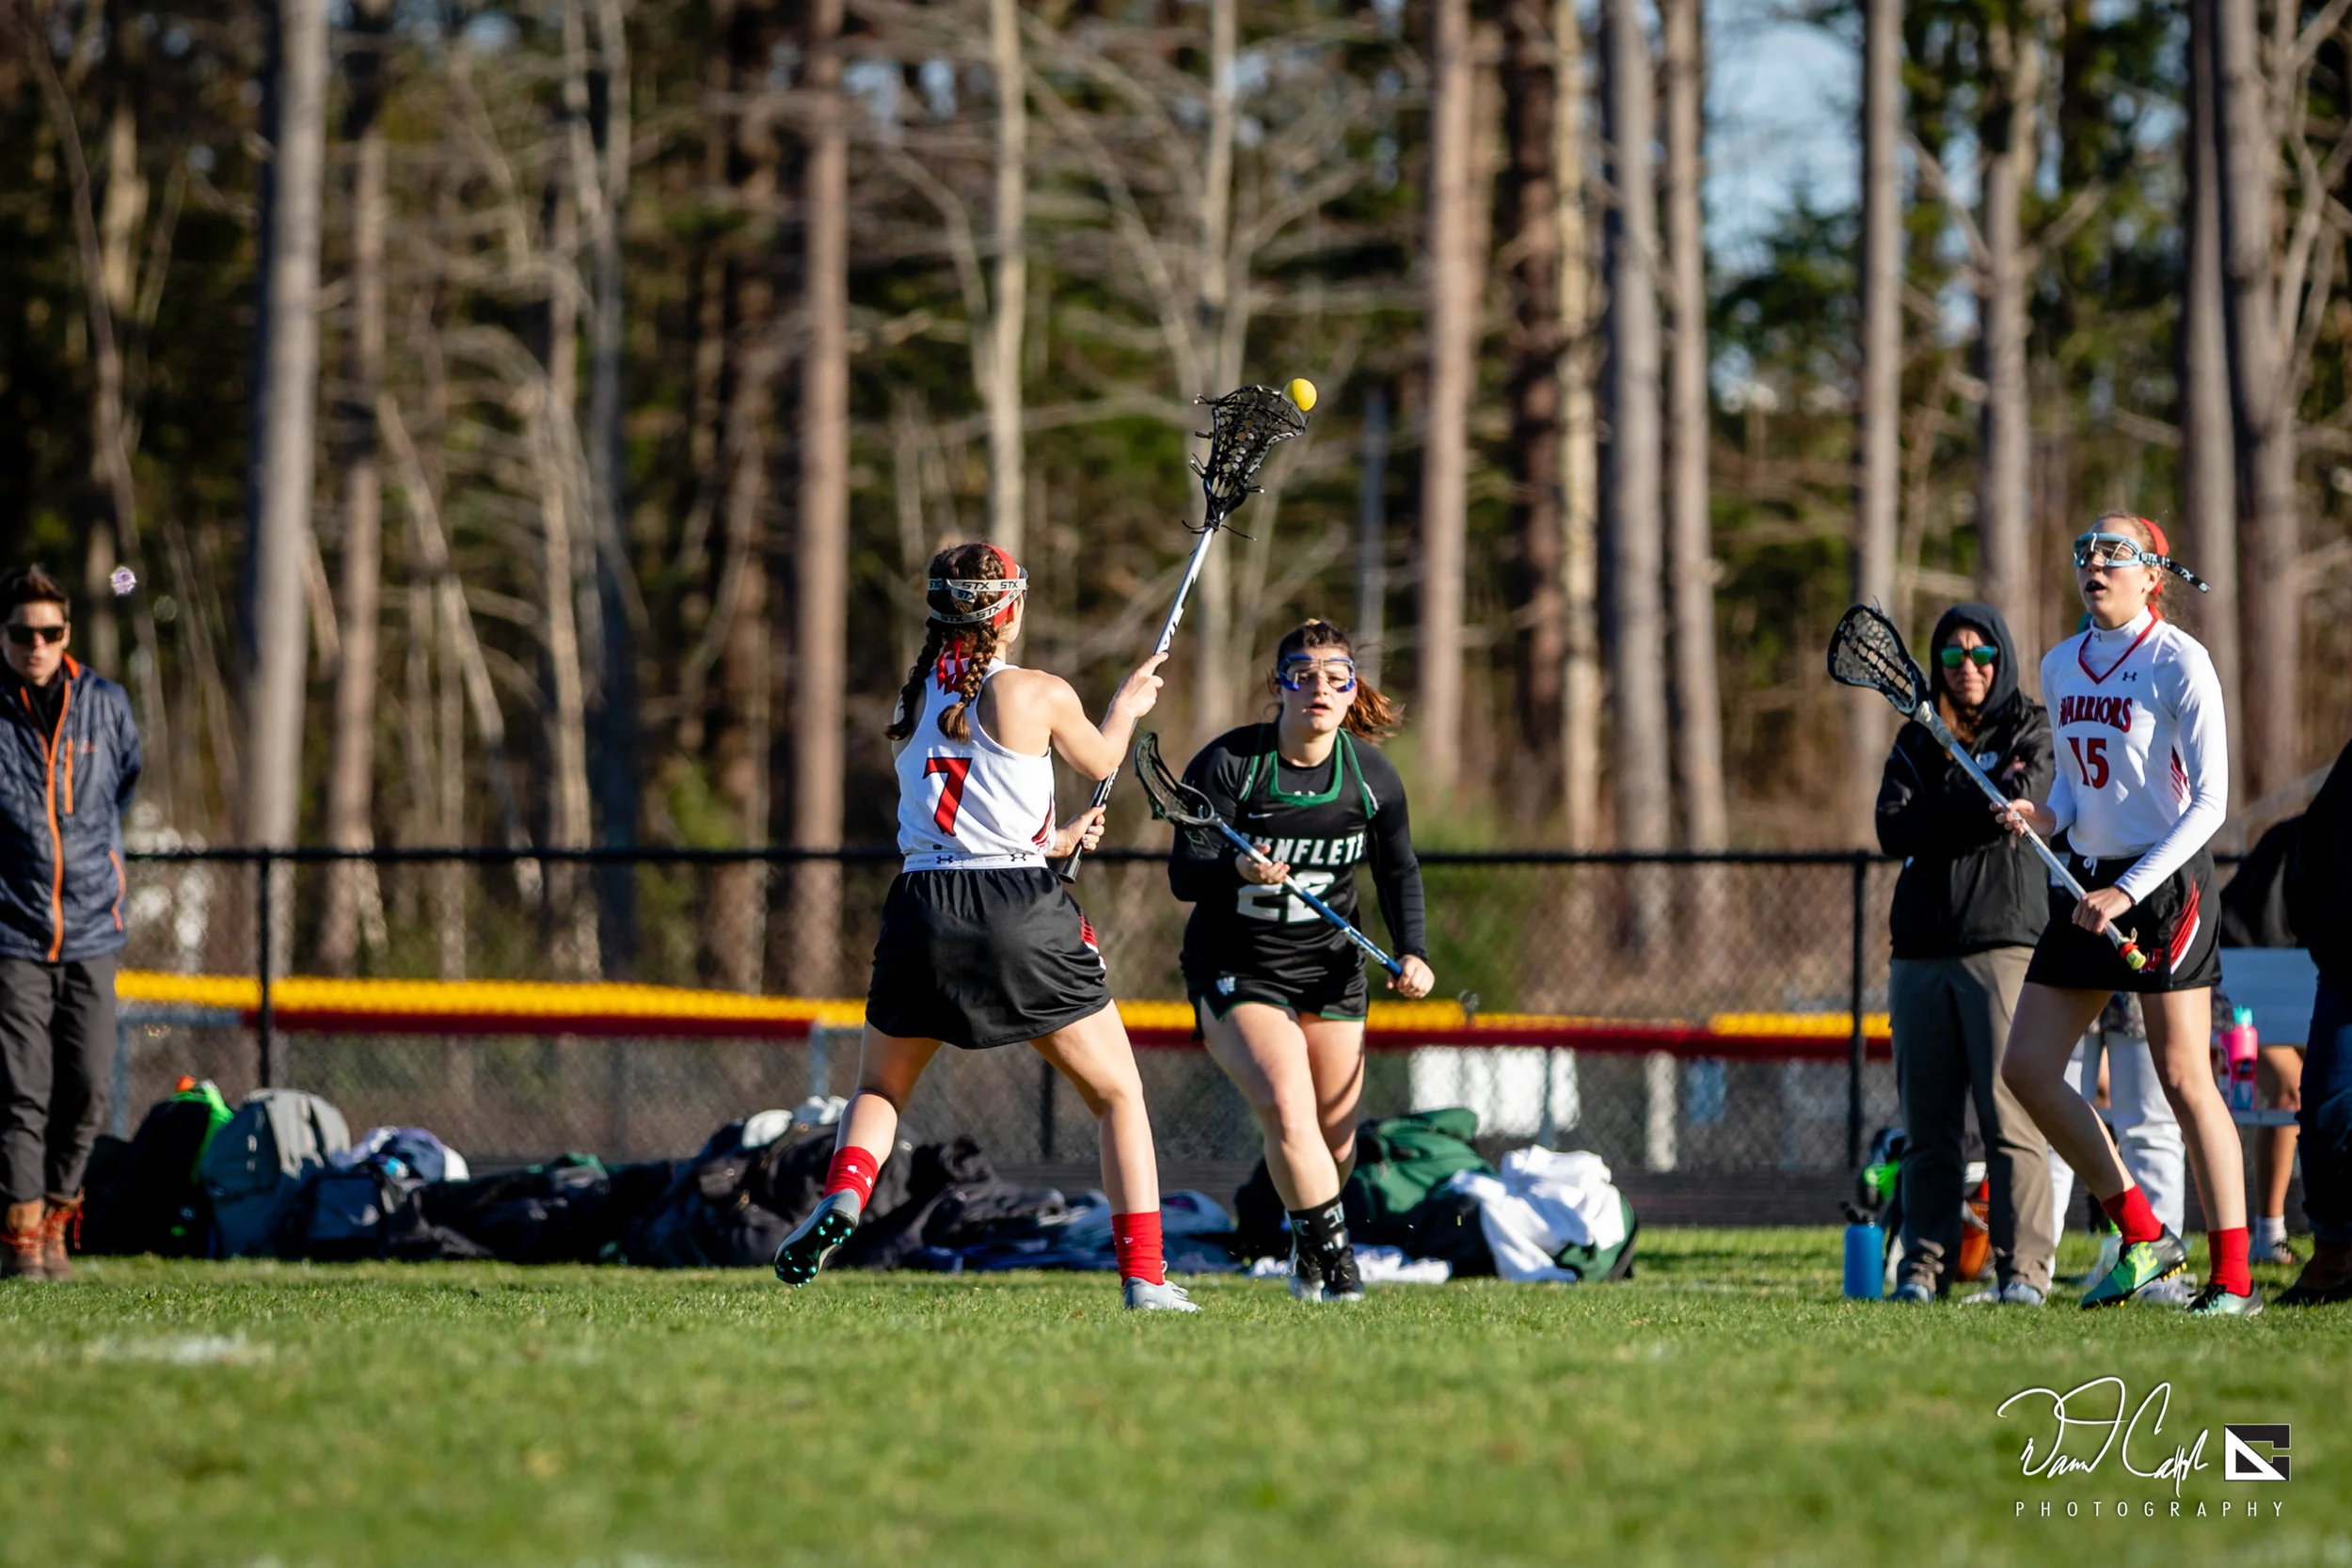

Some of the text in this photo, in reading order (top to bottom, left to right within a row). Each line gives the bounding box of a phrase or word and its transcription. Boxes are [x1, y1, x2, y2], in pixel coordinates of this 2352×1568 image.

[962, 581, 990, 590] STX
[1000, 580, 1018, 590] STX
[977, 603, 1001, 619] STX
[2058, 695, 2133, 733] WARRIORS
[2067, 736, 2109, 789] 15
[922, 756, 973, 837] 7
